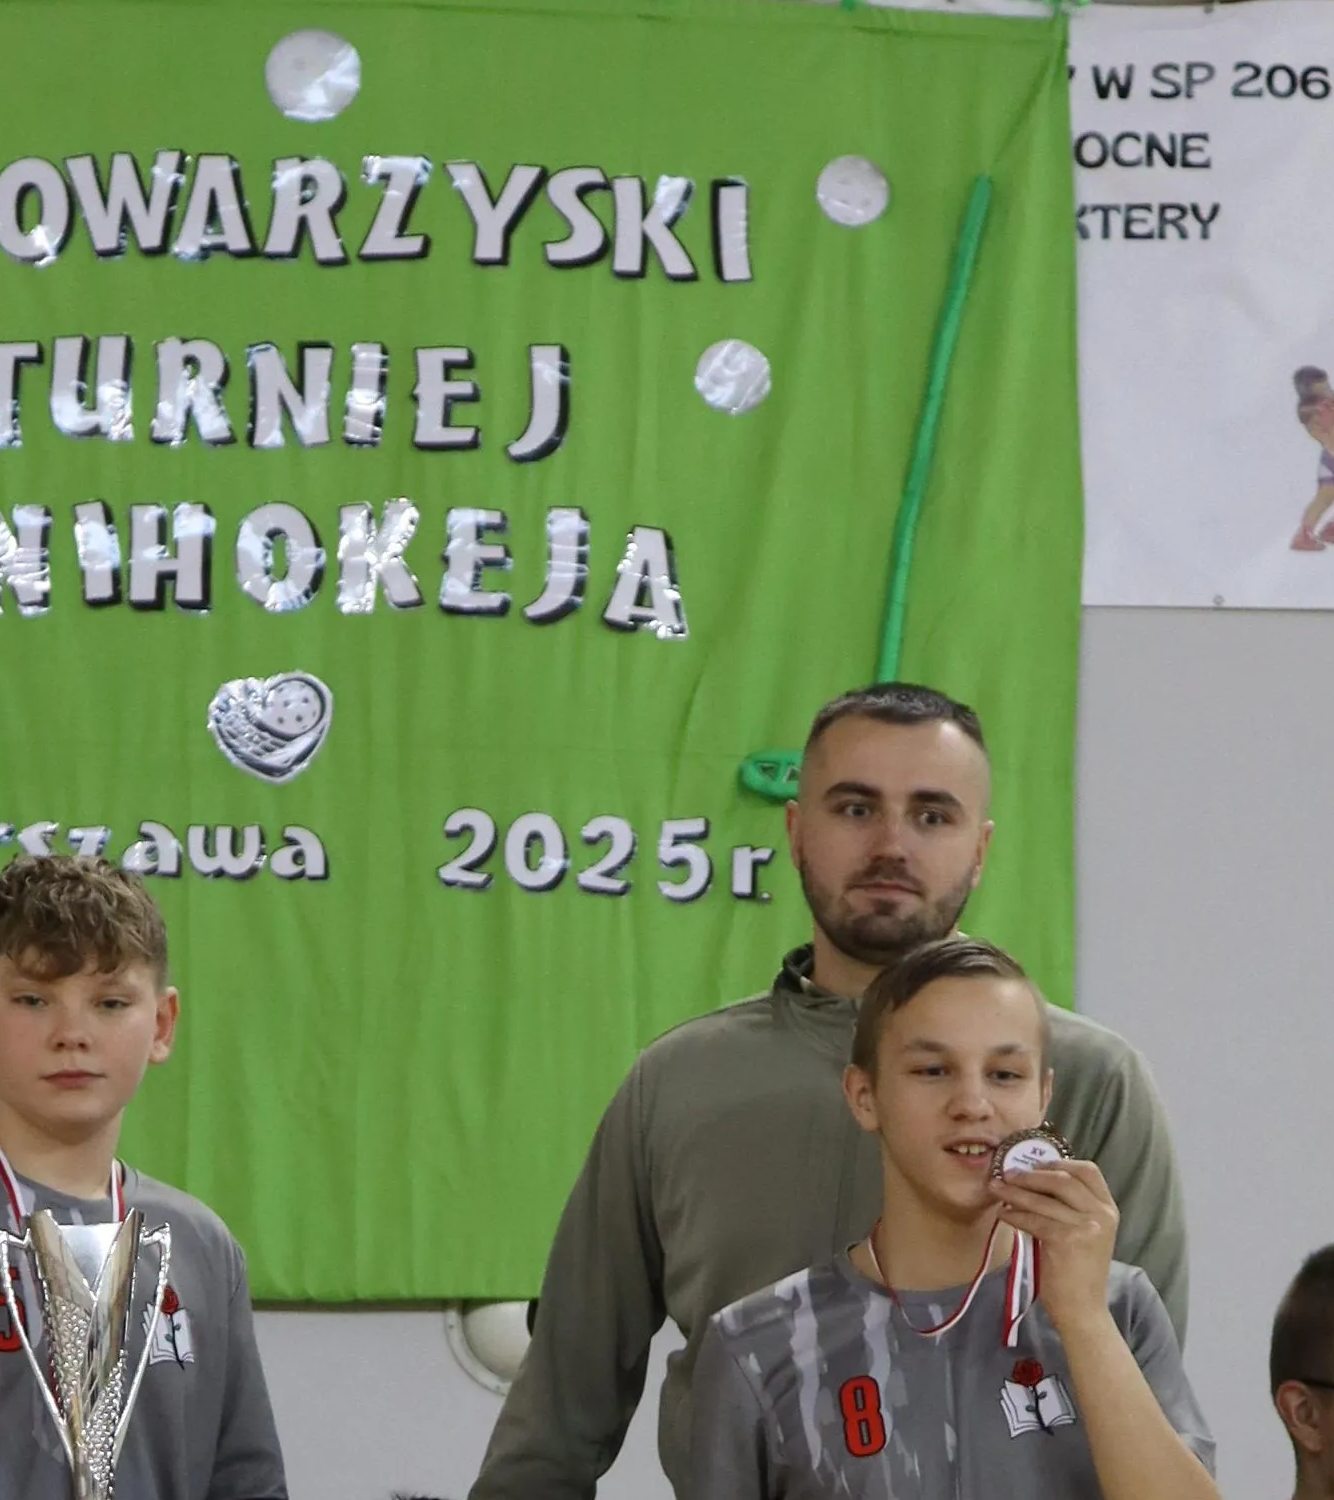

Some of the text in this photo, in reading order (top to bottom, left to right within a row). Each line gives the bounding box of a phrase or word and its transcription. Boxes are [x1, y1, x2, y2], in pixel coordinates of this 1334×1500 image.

[1092, 60, 1332, 100] W SP 206
[839, 1375, 887, 1458] 8
